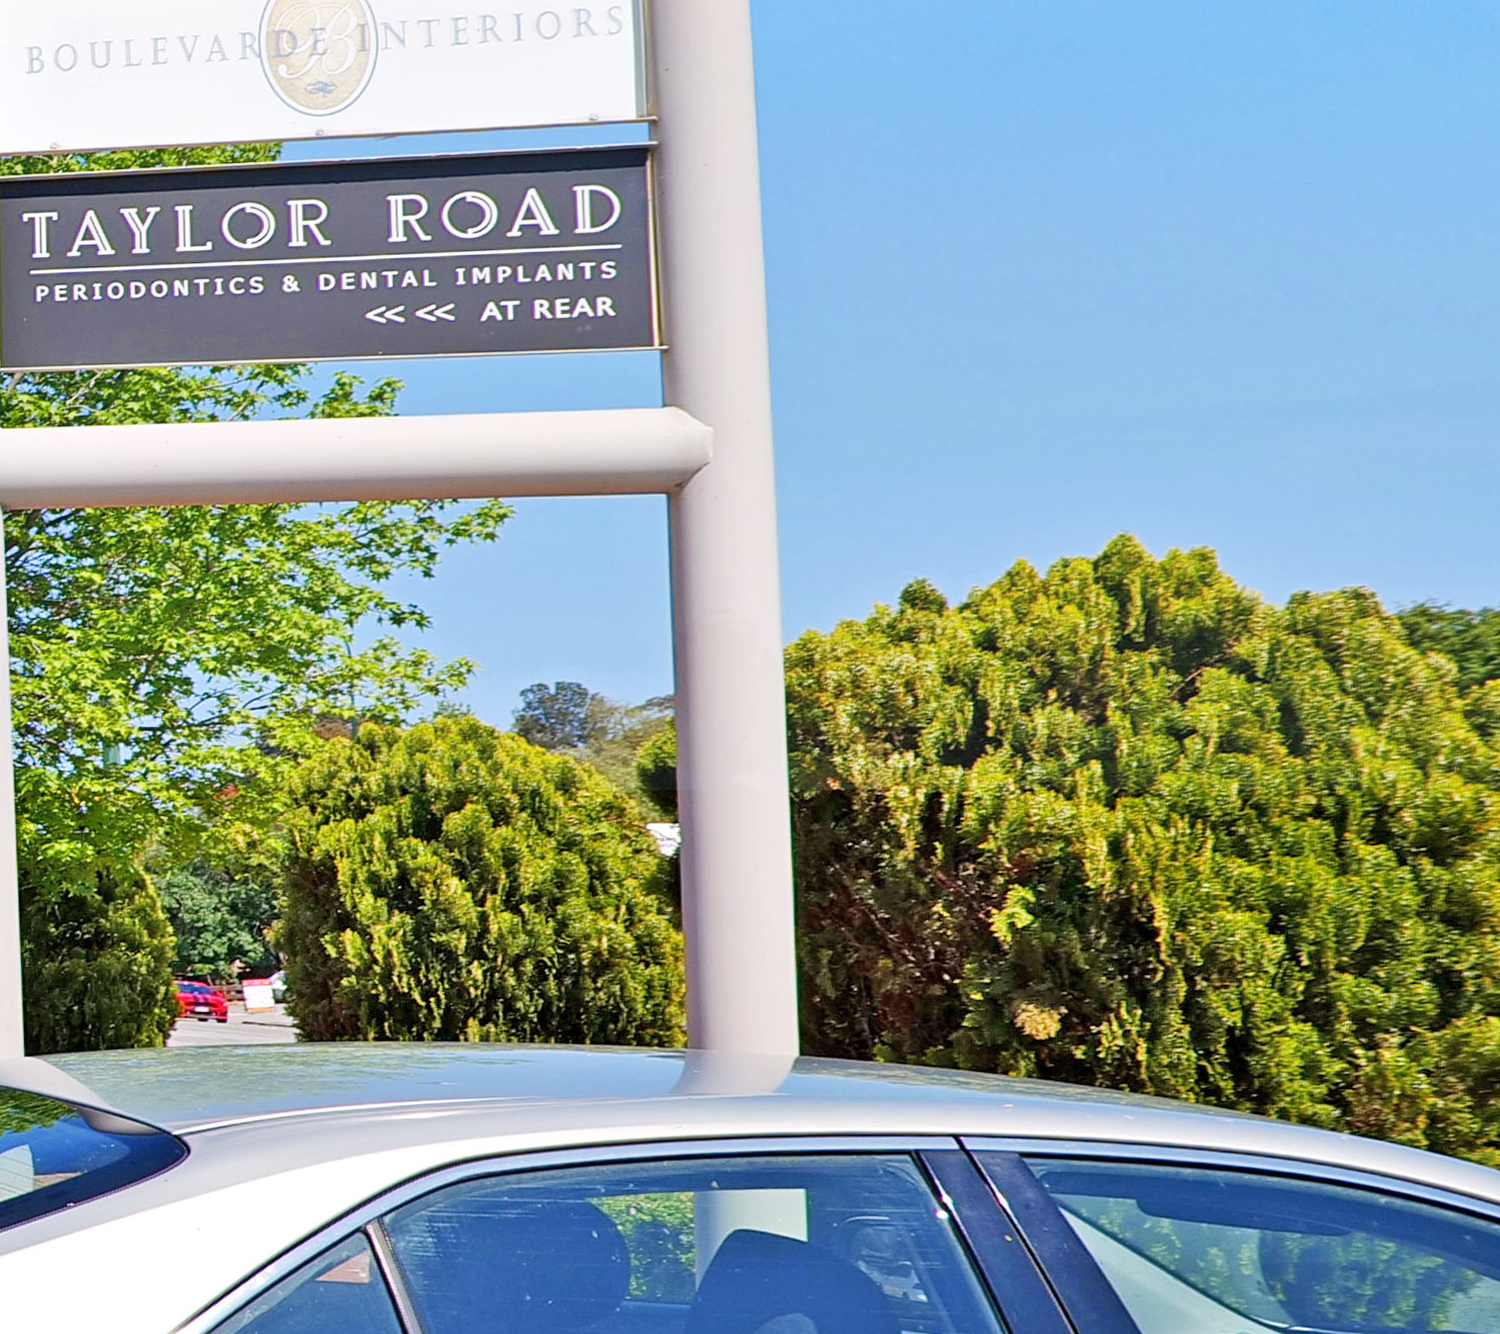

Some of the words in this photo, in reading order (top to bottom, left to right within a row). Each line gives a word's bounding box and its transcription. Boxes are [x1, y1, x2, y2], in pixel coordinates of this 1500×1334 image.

[25, 26, 329, 76] BOULEVARDE
[357, 5, 625, 53] INTERIORS
[22, 198, 332, 261] TAYLOR
[387, 185, 622, 244] ROAD
[35, 275, 266, 304] PERIODONTICS
[282, 274, 300, 294] &
[318, 268, 438, 291] DENTAL
[455, 260, 619, 286] IMPLANTS
[480, 299, 521, 322] AT
[534, 295, 617, 320] REAR
